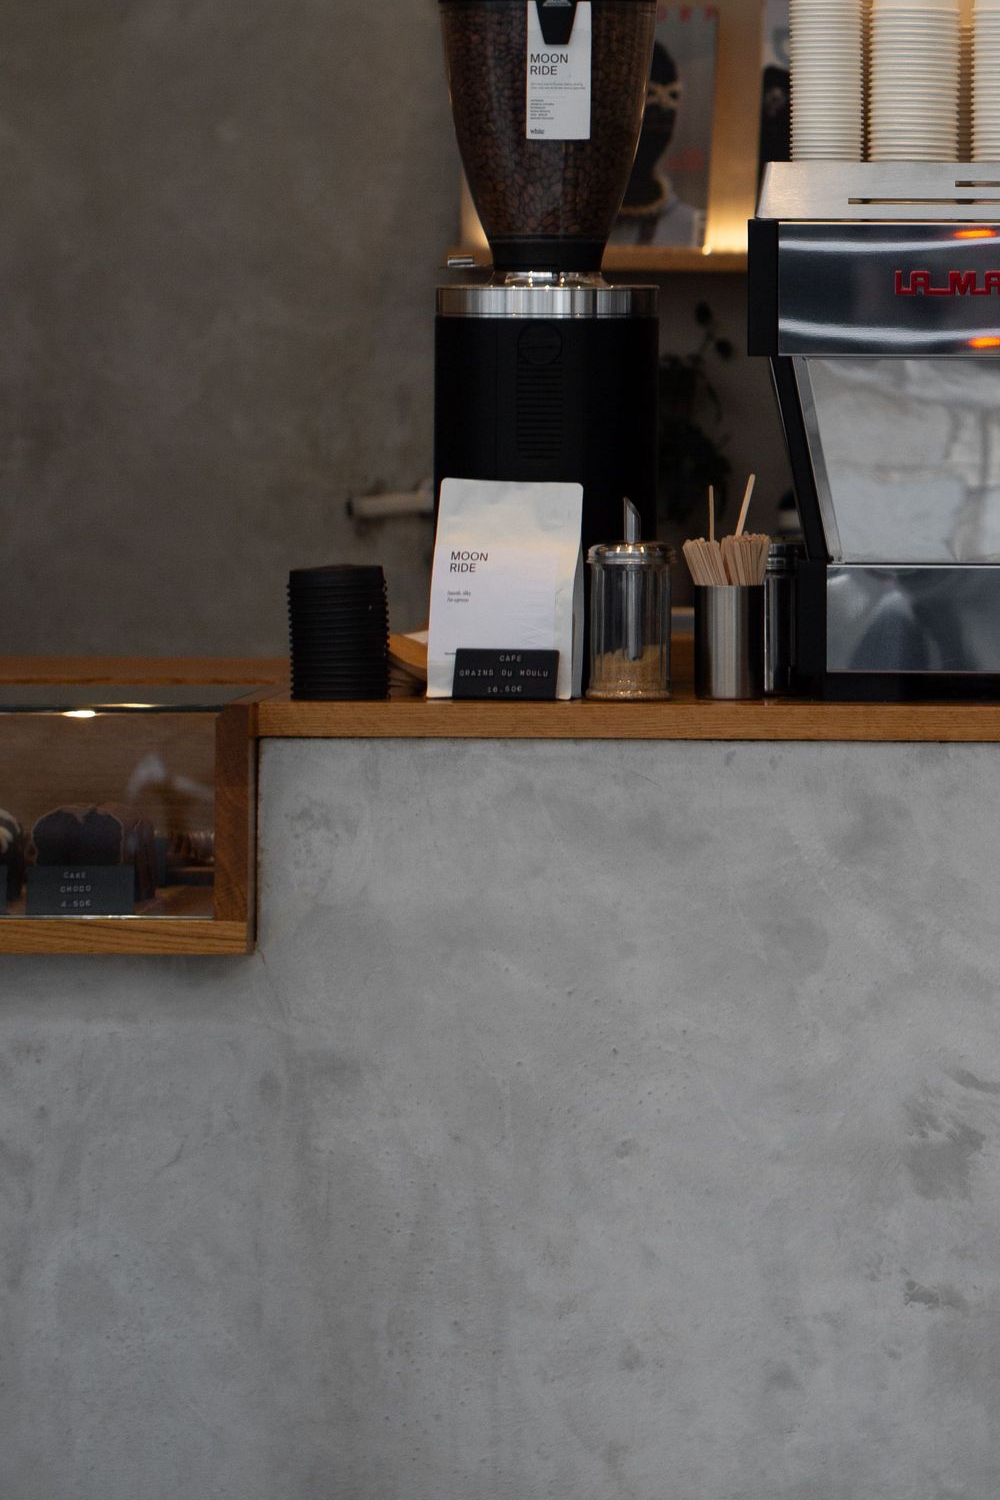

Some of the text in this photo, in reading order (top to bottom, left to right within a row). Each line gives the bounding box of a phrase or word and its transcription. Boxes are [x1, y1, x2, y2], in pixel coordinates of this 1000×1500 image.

[530, 53, 569, 64] MOON
[530, 65, 558, 76] RIDE
[895, 270, 930, 296] LA
[450, 551, 488, 562] MOON
[449, 563, 476, 573] RIDE
[499, 654, 522, 662] CAFE
[459, 669, 549, 677] GRAINS OU MOULU
[63, 871, 87, 879] CAKE
